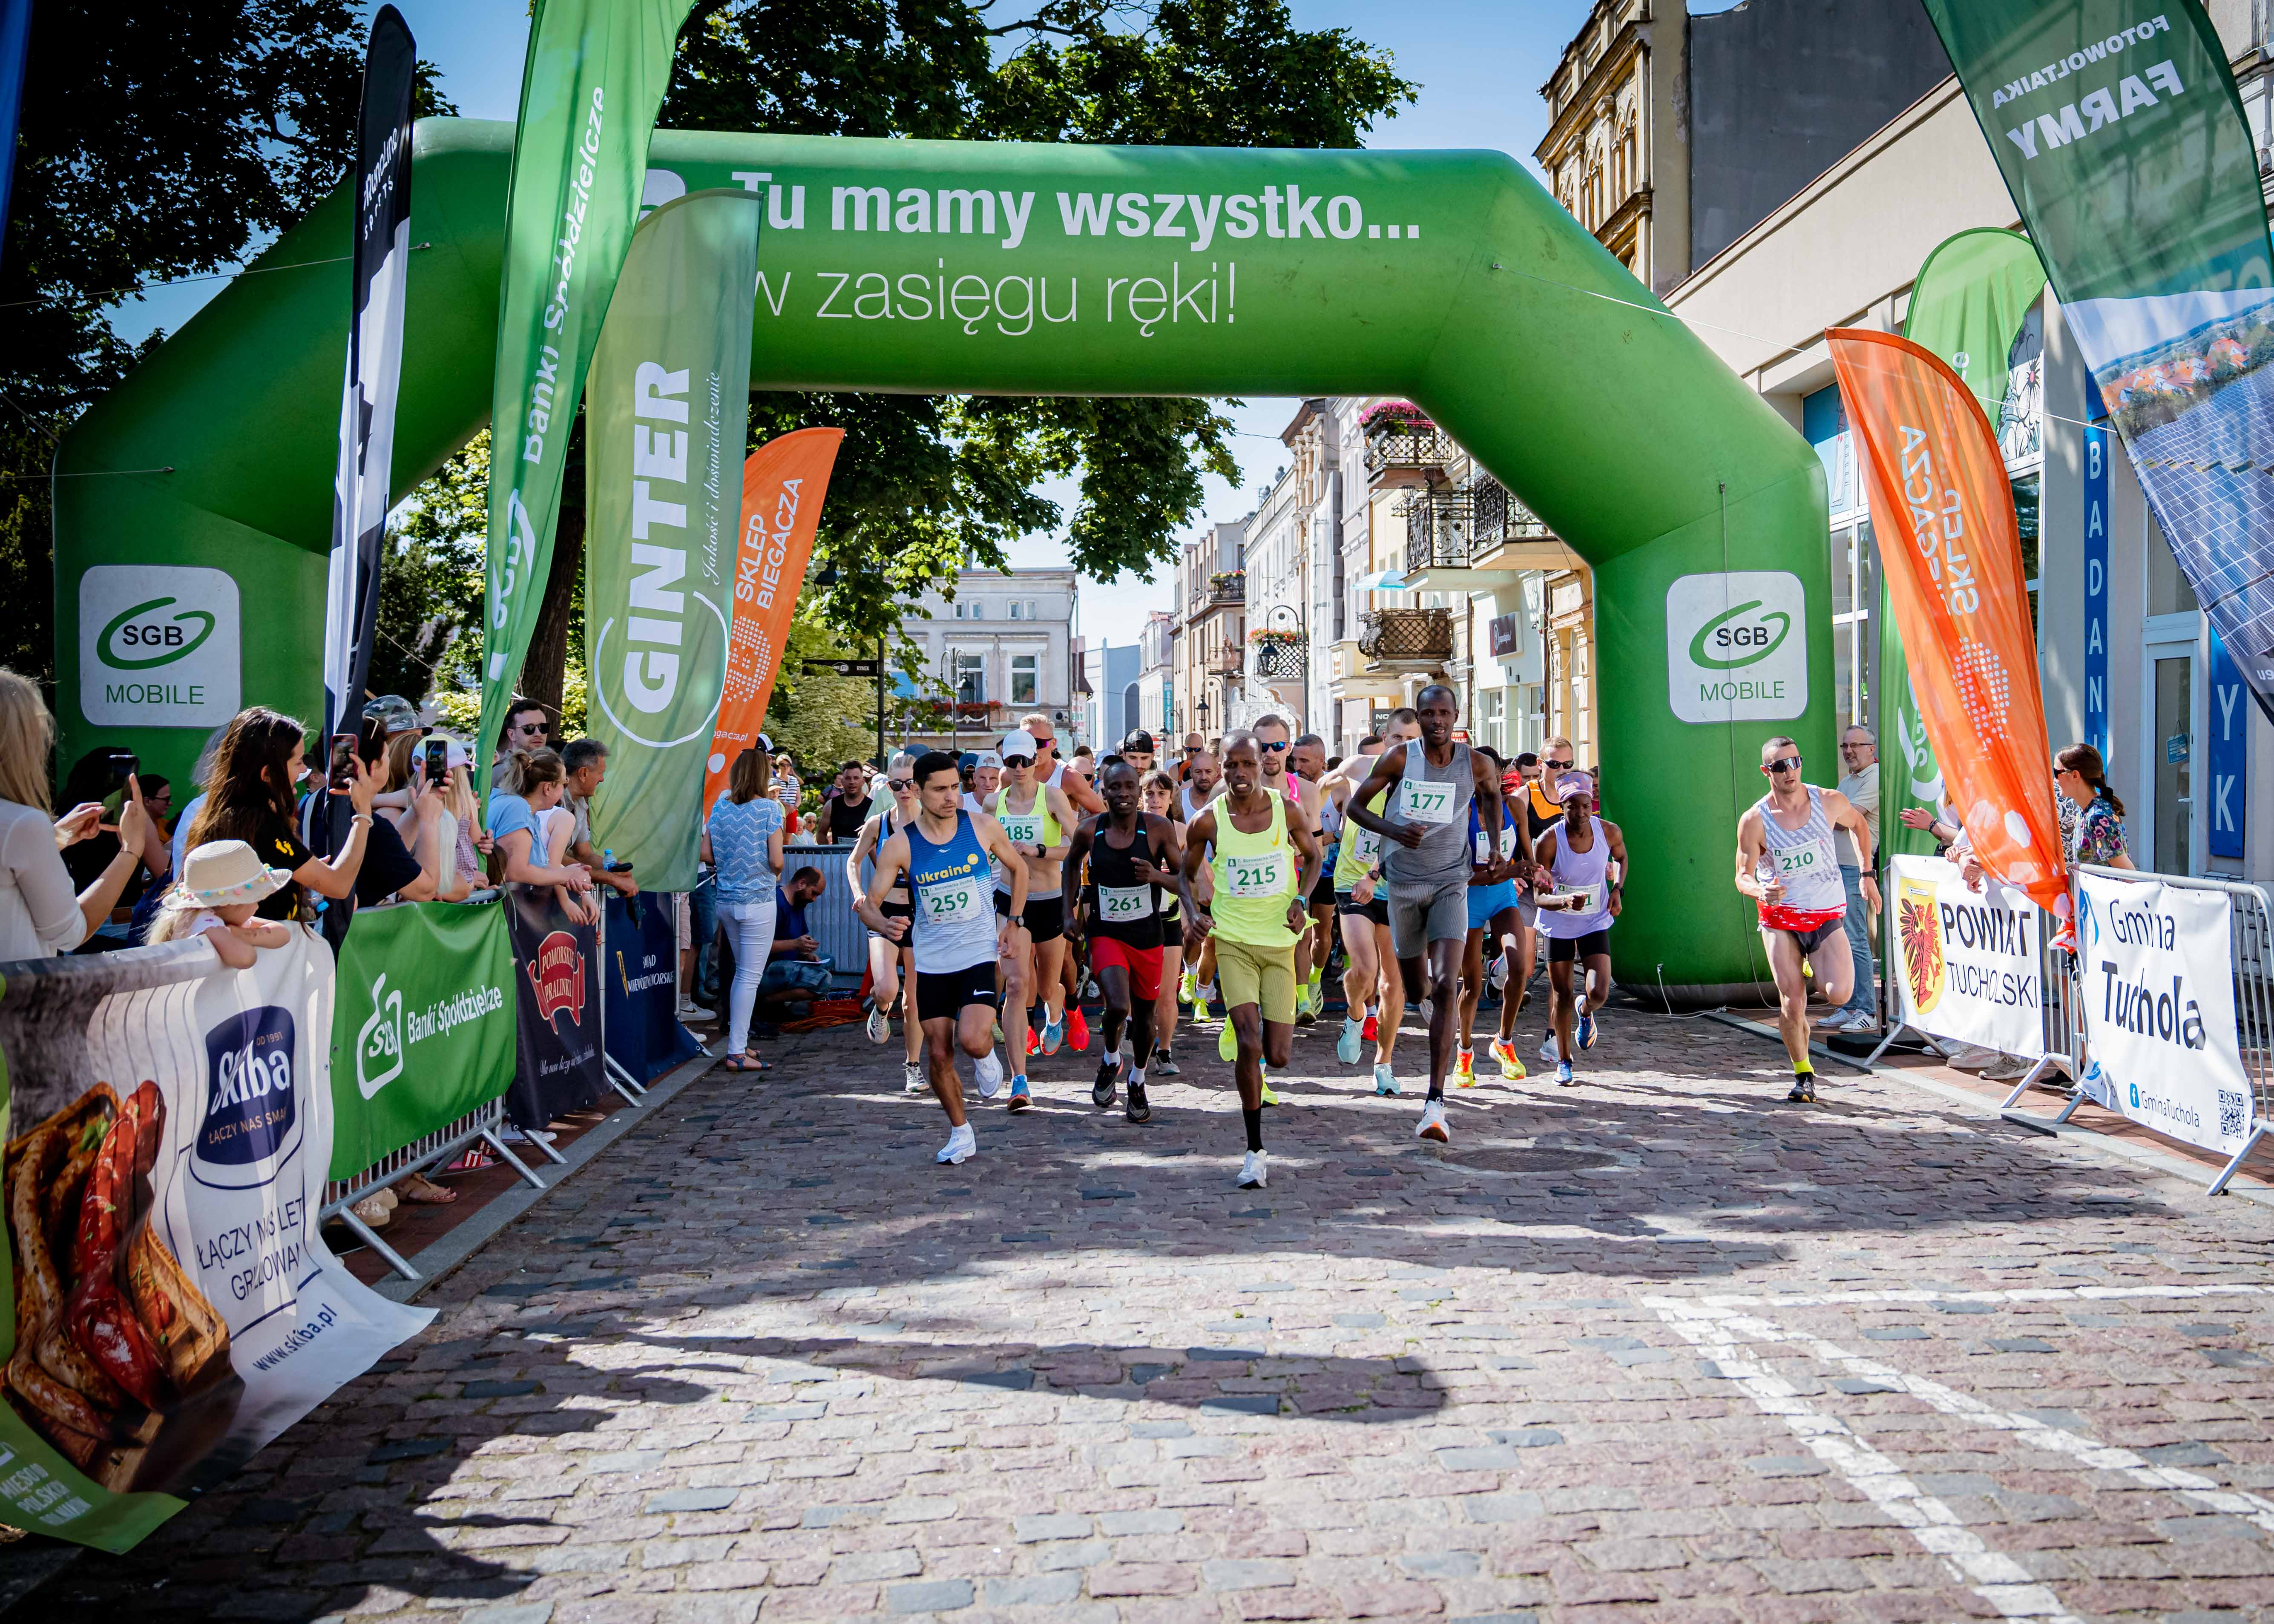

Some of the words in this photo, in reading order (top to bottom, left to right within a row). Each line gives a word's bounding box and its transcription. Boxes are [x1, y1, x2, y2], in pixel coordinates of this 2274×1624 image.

[732, 172, 804, 228] Tu
[831, 187, 1035, 249] mamy
[1057, 185, 1420, 252] wszystko...
[523, 345, 559, 465] Banki
[544, 87, 605, 335] Spółdzielcze
[816, 259, 1077, 336] zasięgu
[1107, 262, 1236, 337] ręki!
[703, 371, 720, 499] doświadczenie
[706, 502, 719, 512] i
[624, 361, 690, 713] GINTER
[702, 514, 720, 585] Jakość
[756, 479, 803, 609] BIEGACZA
[735, 514, 765, 602] SKLEP
[122, 625, 184, 646] SGB
[1716, 627, 1768, 647] SGB
[106, 684, 204, 705] MOBILE
[1700, 681, 1785, 702] MOBILE
[1410, 793, 1445, 810] 177
[1005, 826, 1033, 840] 185
[916, 864, 972, 884] Ukraine
[1237, 865, 1276, 886] 215
[1782, 852, 1813, 870] 210
[931, 892, 968, 913] 259
[1108, 896, 1142, 911] 261
[1941, 902, 2031, 957] POWIAT
[2110, 898, 2175, 951] Gmina
[542, 946, 574, 974] POMORSKIE
[544, 978, 572, 1003] PRALINKI
[1947, 961, 2038, 1009] TUCHOLSKI
[408, 1003, 437, 1044] Banki
[437, 985, 503, 1037] Spółdzielcze
[2102, 960, 2207, 1050] Tuchola
[256, 1036, 265, 1046] OD
[266, 1031, 283, 1043] 1991
[210, 1039, 290, 1116] Skiba
[2141, 1090, 2200, 1128] GminaTuchola
[209, 1122, 238, 1145] ŁĄCZY
[240, 1115, 263, 1133] NAS
[197, 1223, 252, 1270] ŁĄCZY
[252, 1303, 338, 1371] www.skiba.pl
